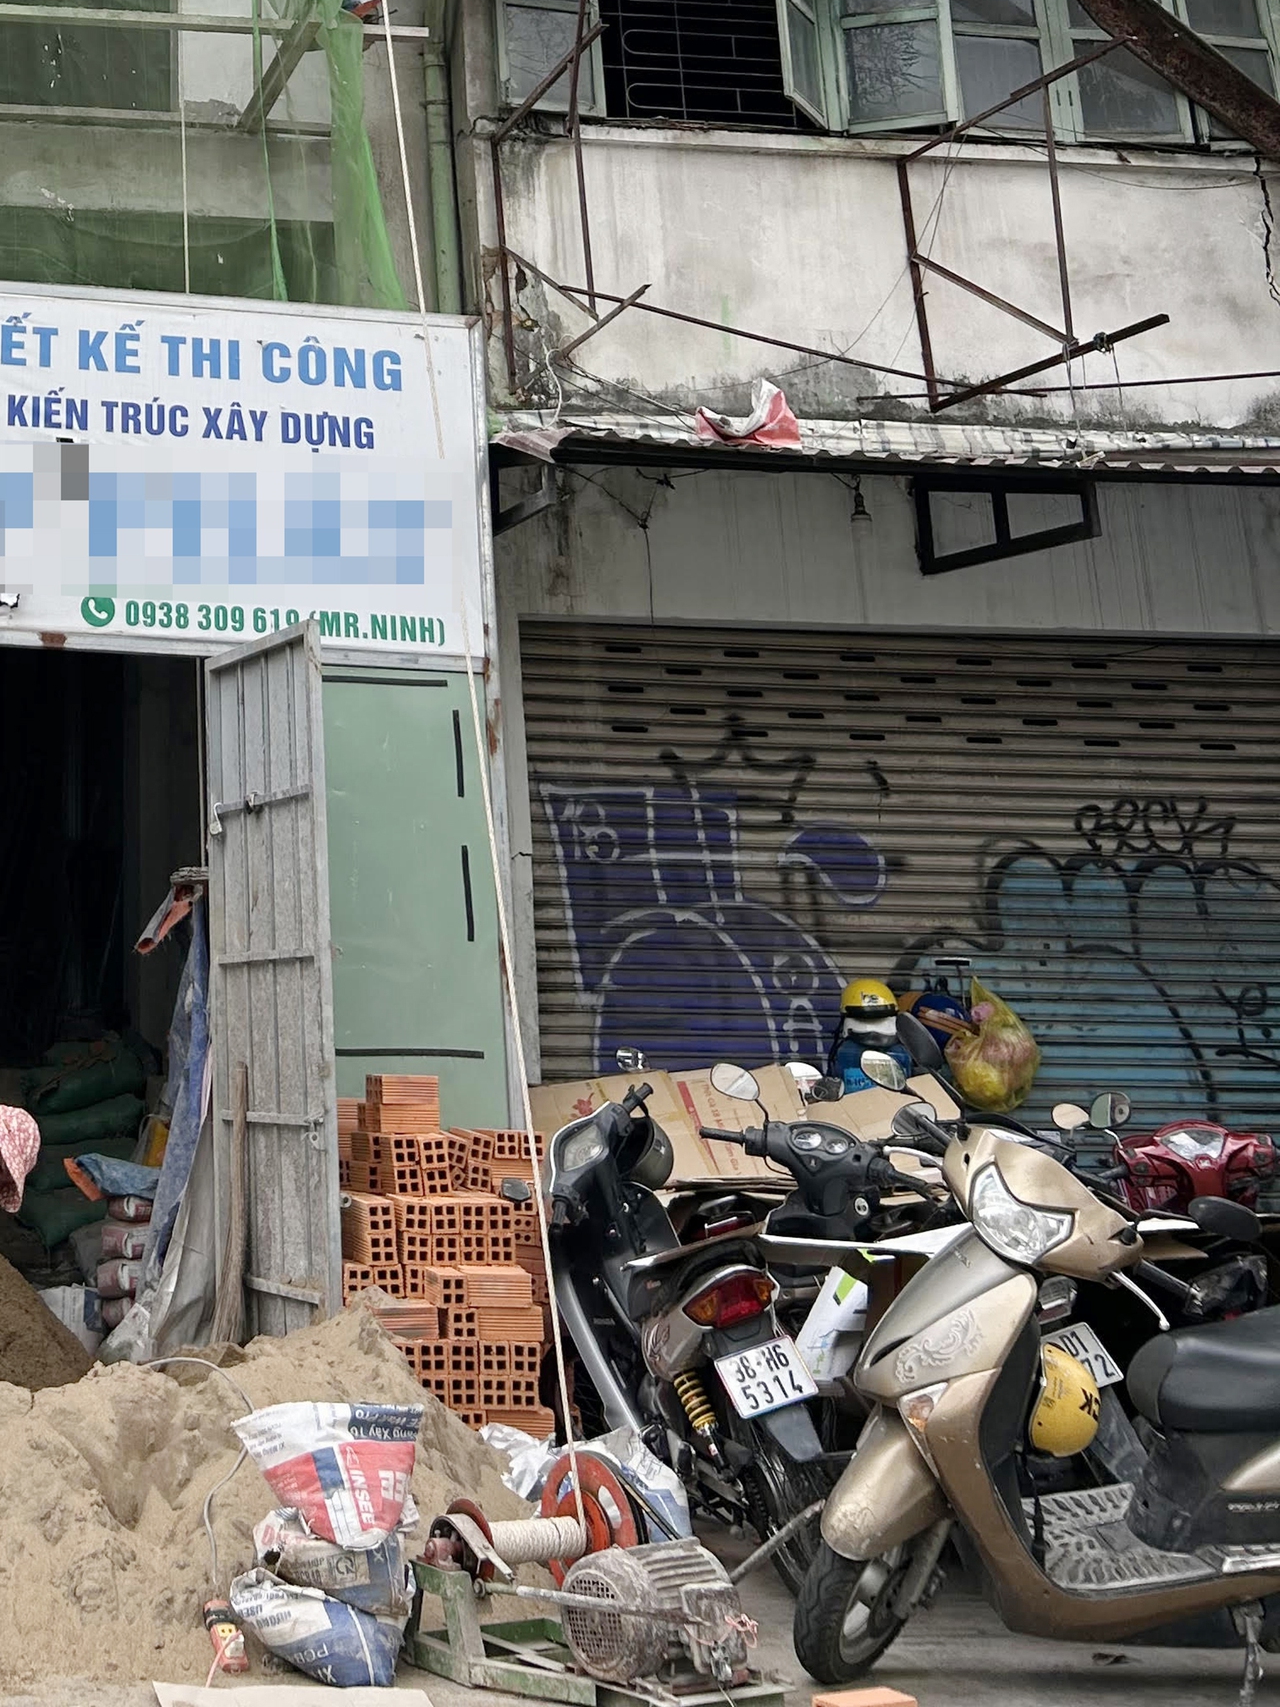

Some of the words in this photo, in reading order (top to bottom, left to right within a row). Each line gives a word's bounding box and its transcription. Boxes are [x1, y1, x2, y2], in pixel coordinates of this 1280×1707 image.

[77, 320, 146, 374] KẾ
[160, 334, 242, 381] THI
[261, 336, 403, 392] CÔNG
[7, 386, 89, 431] KIẾN
[100, 396, 189, 437] TRÚC
[201, 401, 268, 442] XÂY
[281, 410, 375, 453] DỰNG
[124, 600, 190, 630] 0938
[197, 604, 245, 632] 309
[740, 1370, 804, 1410] 5314
[348, 1468, 376, 1525] INSEE
